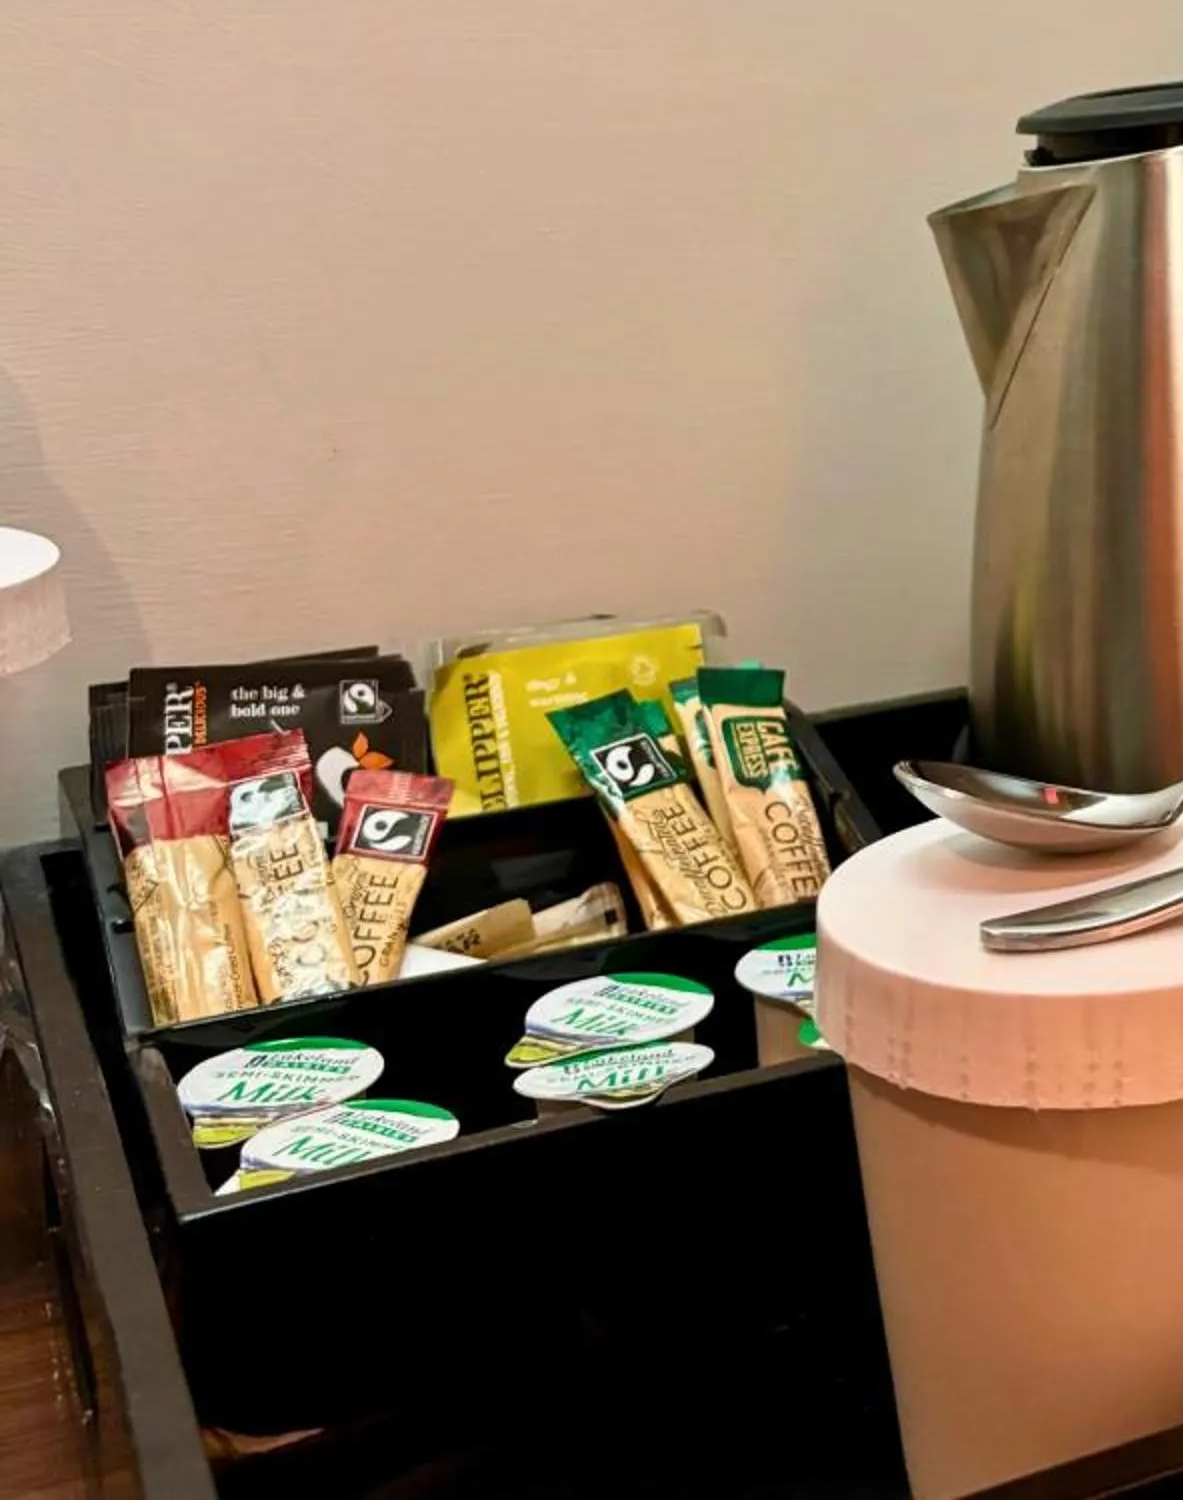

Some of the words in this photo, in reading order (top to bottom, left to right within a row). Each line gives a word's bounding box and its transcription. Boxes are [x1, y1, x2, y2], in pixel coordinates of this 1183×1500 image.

[231, 686, 258, 700] the
[262, 685, 289, 702] big
[292, 684, 305, 699] &
[230, 703, 265, 718] bold
[269, 704, 301, 716] one
[661, 802, 747, 911] COFFEE
[216, 1080, 326, 1103] Milk
